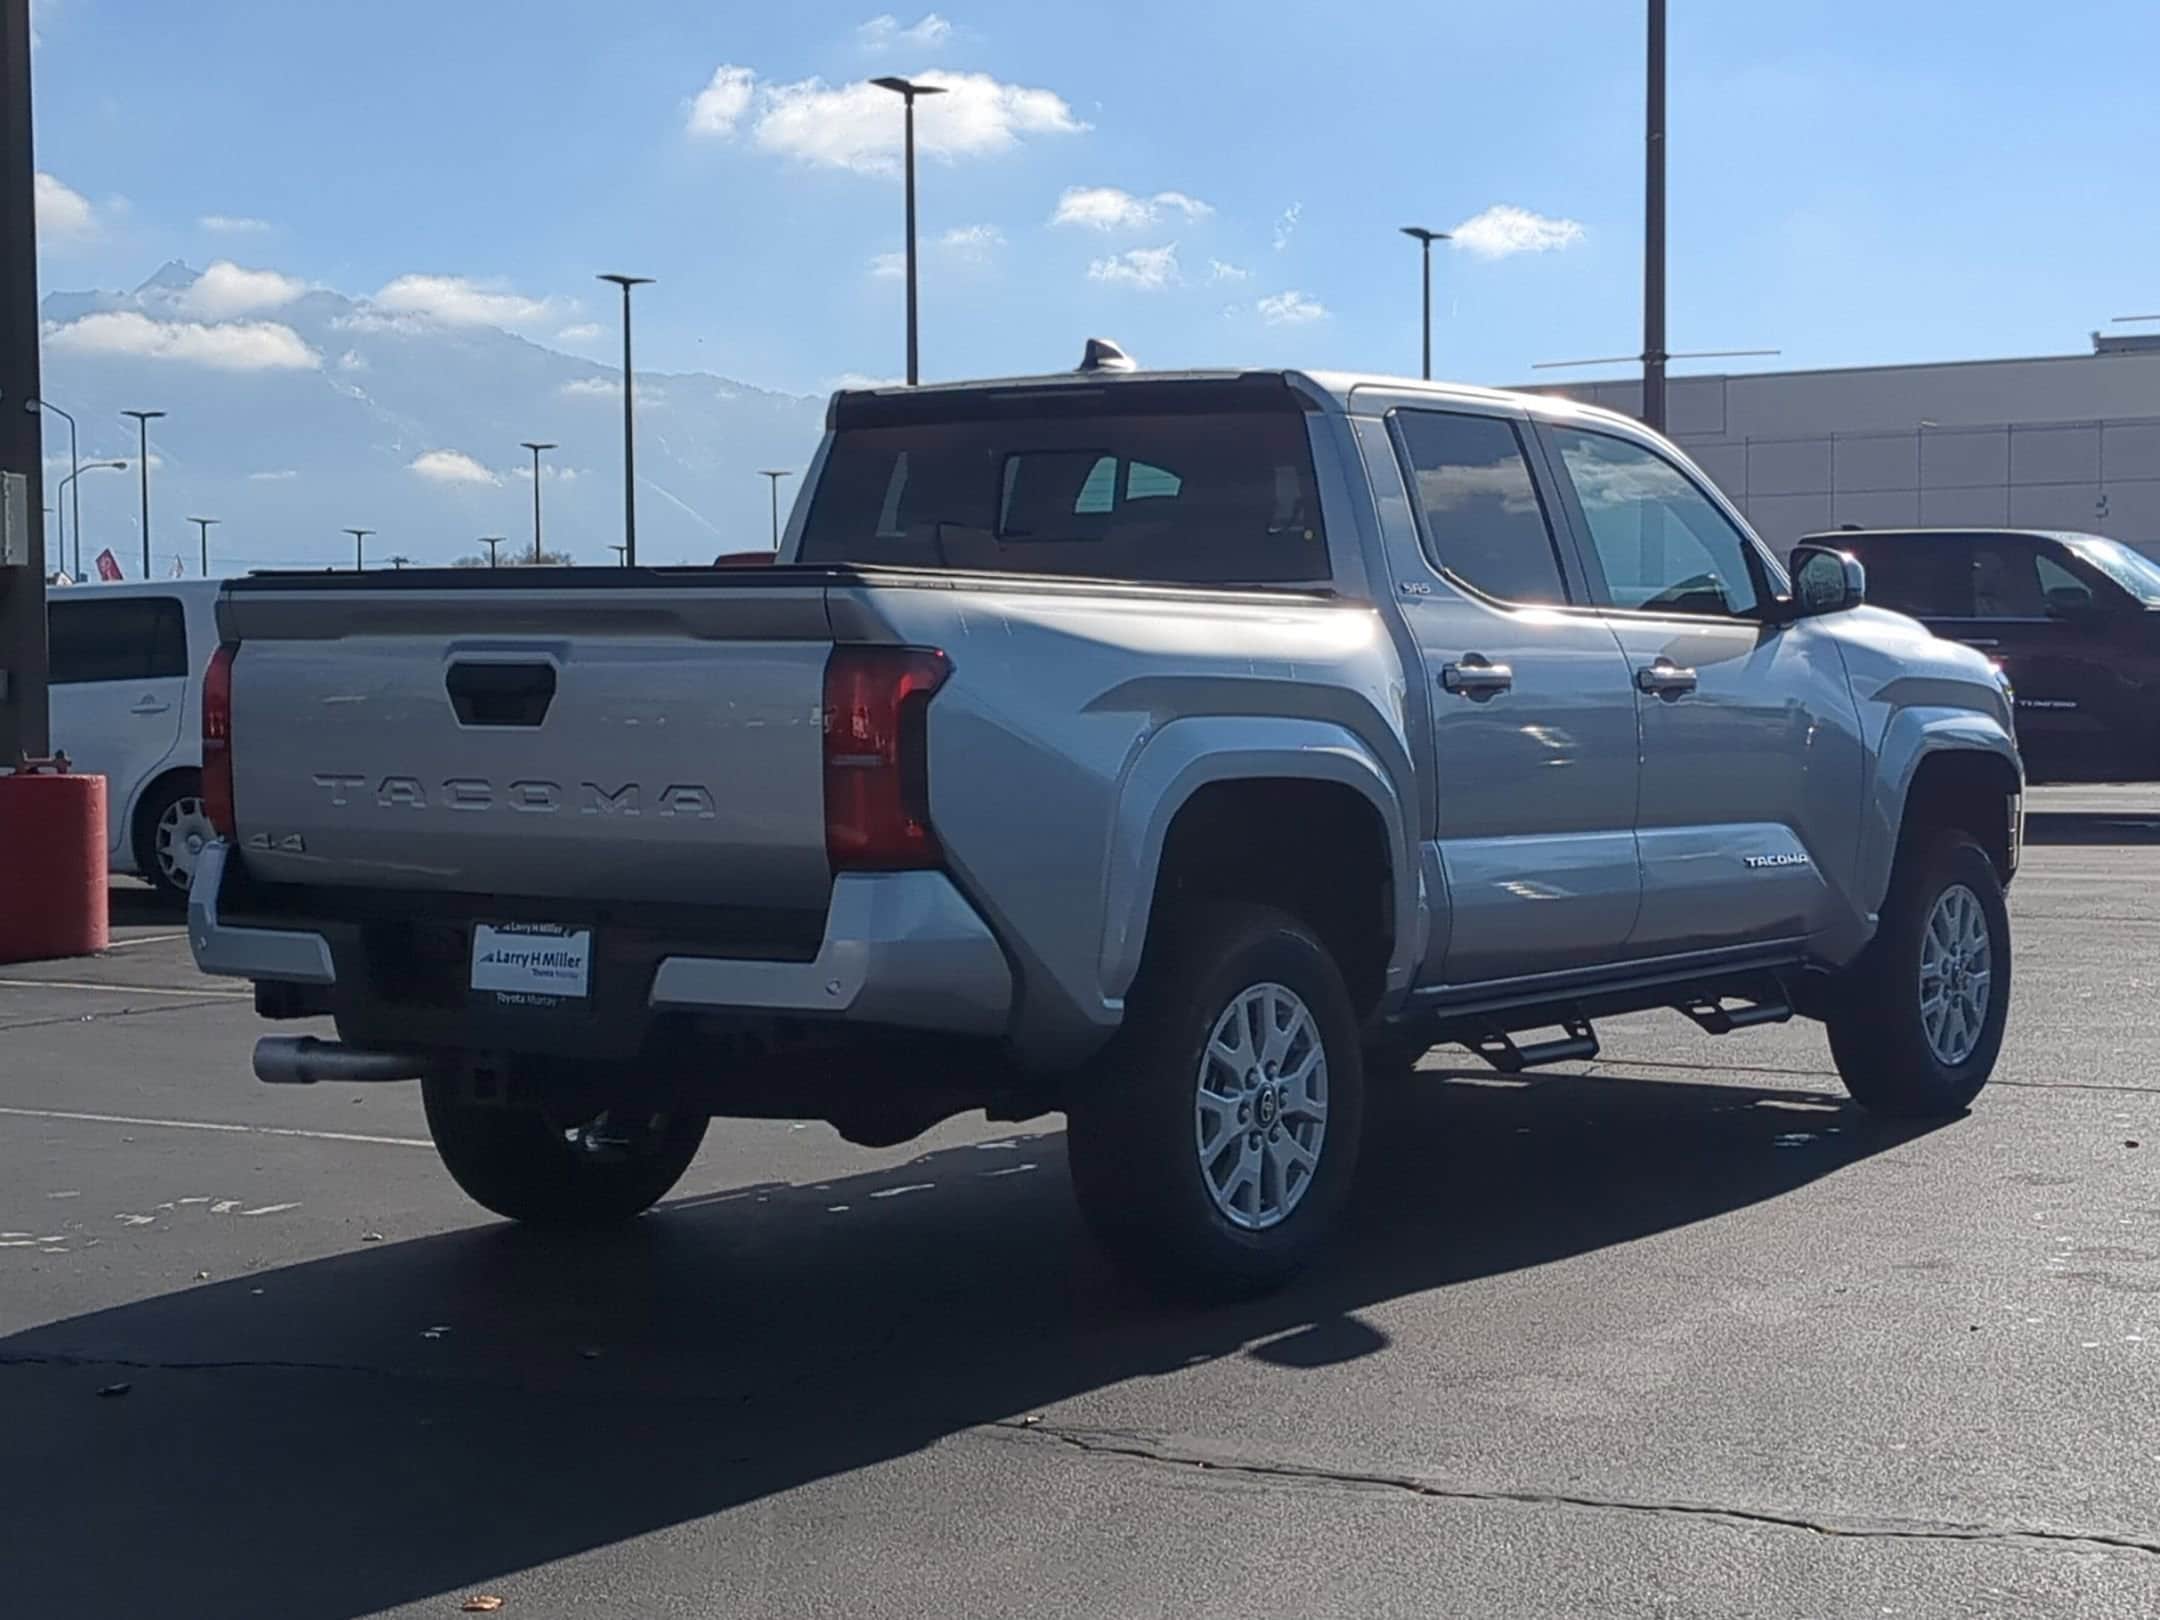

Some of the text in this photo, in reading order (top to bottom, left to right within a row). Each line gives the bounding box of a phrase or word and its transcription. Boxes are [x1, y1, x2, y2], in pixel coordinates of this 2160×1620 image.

[313, 773, 716, 819] TACOMA
[1744, 853, 1809, 868] TACOMA
[496, 949, 582, 968] Larry H Miller
